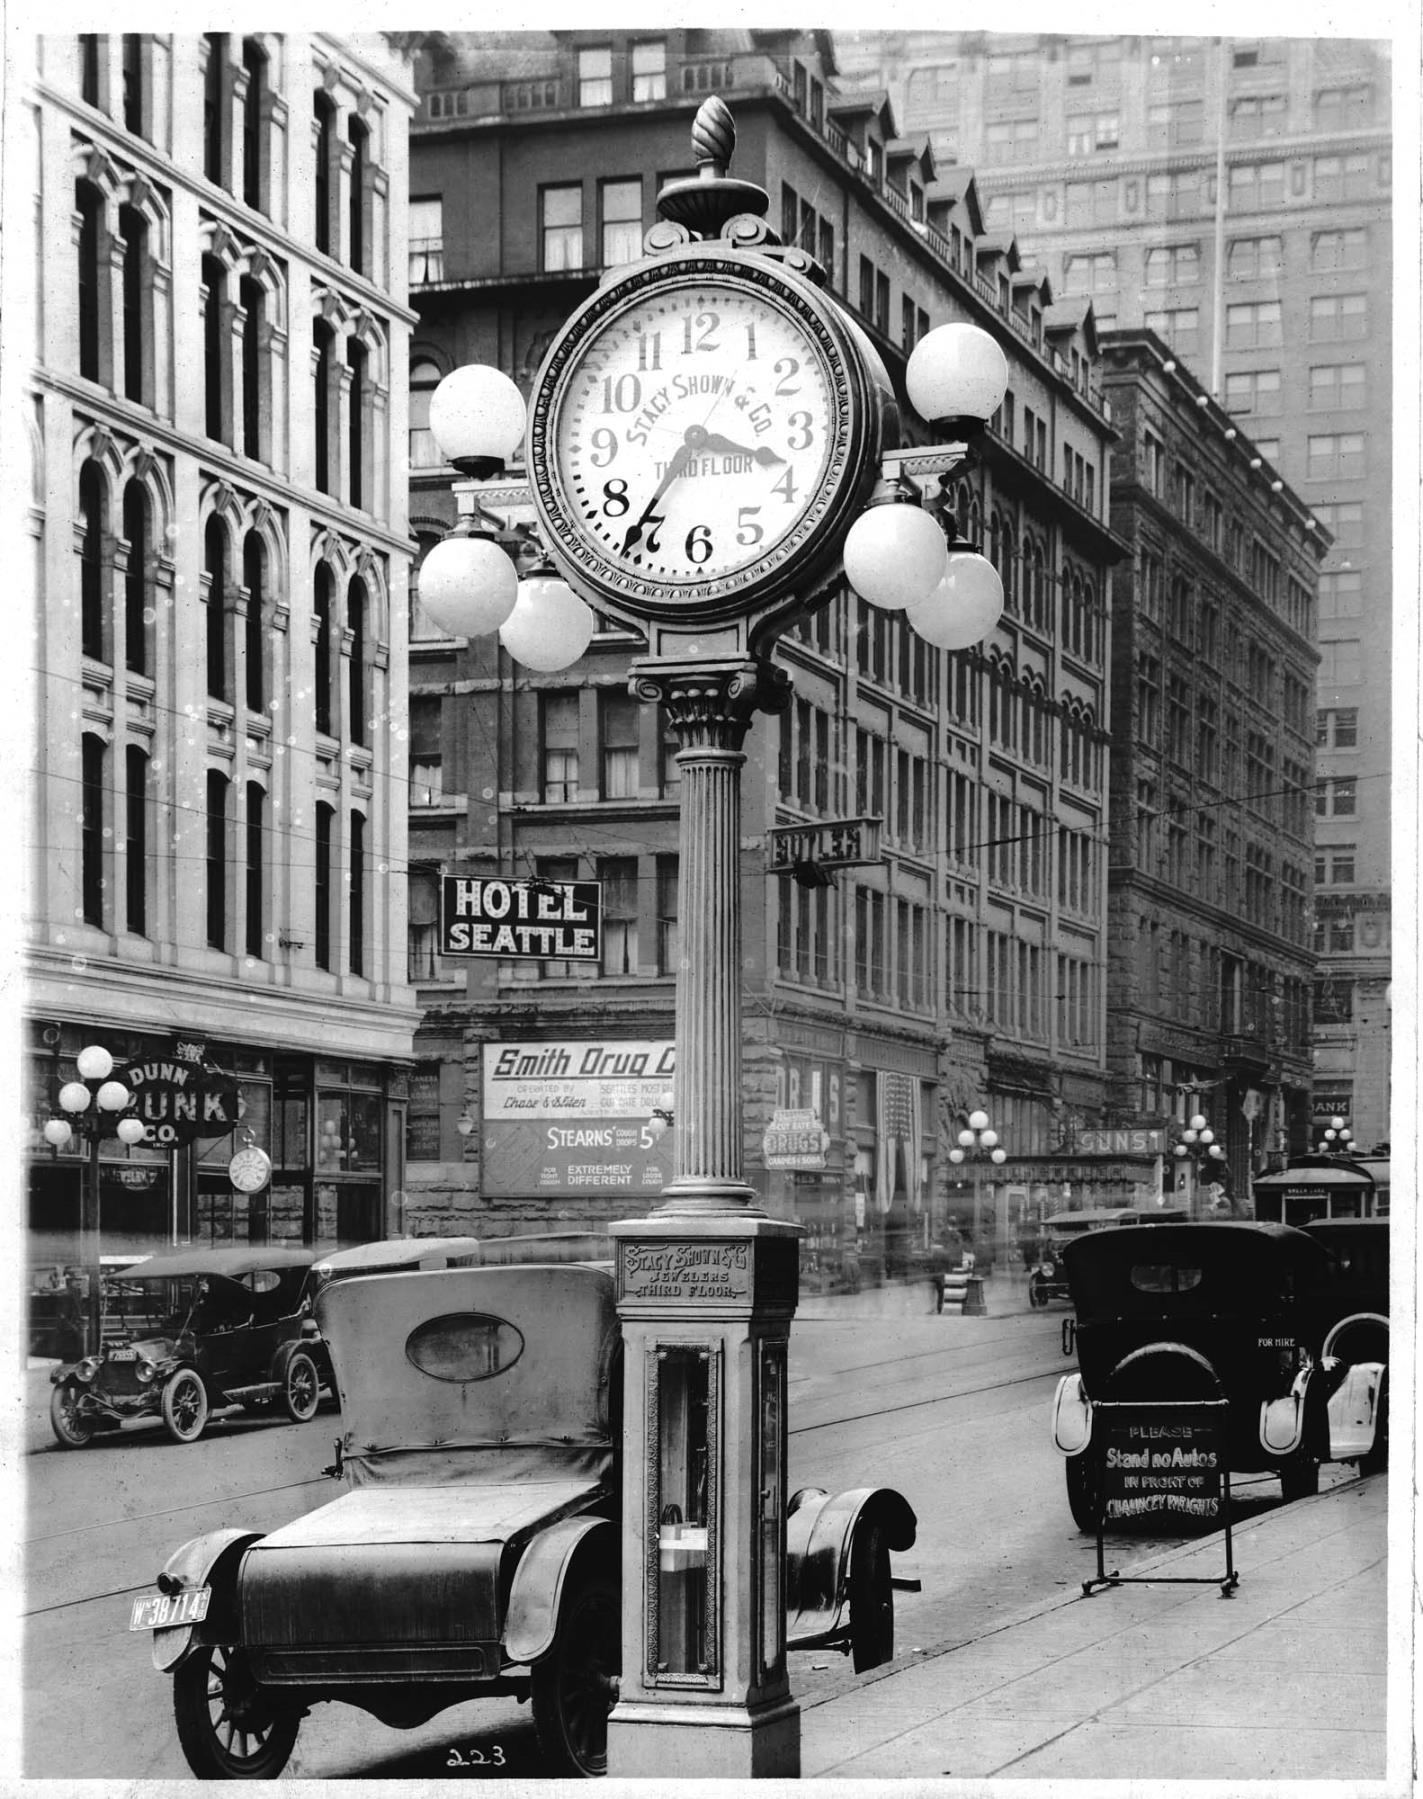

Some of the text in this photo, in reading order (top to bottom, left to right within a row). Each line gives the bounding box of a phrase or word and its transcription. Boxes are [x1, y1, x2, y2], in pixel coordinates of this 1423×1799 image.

[681, 312, 720, 355] 12
[744, 322, 759, 361] 1
[637, 331, 663, 371] 11
[774, 358, 801, 396] 2
[600, 373, 641, 414] 10
[626, 387, 671, 447] STACY
[672, 374, 736, 399] SHOWN
[787, 411, 813, 450] 3
[590, 428, 618, 467] 9
[702, 455, 752, 476] FLOOR
[602, 479, 629, 517] 8
[770, 465, 798, 503] 4
[646, 515, 666, 552] 7
[736, 506, 764, 545] 5
[685, 525, 713, 563] 6
[456, 879, 588, 921] HOTEL
[450, 922, 595, 955] SEATTLE
[128, 1063, 189, 1087] DUNN
[493, 1049, 572, 1076] Smith
[579, 1047, 650, 1076] Drug
[144, 1125, 179, 1142] CO.
[639, 1126, 656, 1149] 5
[765, 1132, 819, 1154] DRUGS
[1081, 1132, 1163, 1151] GUNST
[567, 1164, 633, 1175] EXTREMELY
[567, 1175, 633, 1185] DIFFERENT
[624, 1245, 674, 1279] STACY
[674, 1246, 721, 1271] SHOWN
[649, 1269, 729, 1283] JEWELERS
[638, 1285, 682, 1297] THIRD
[1258, 1338, 1296, 1347] FOR HIRE
[1129, 1426, 1193, 1438] PLEASE
[1106, 1447, 1217, 1468] Stand no Autos
[1124, 1475, 1205, 1488] IN FRONT OF
[1106, 1494, 1167, 1518] CHAUNCEY
